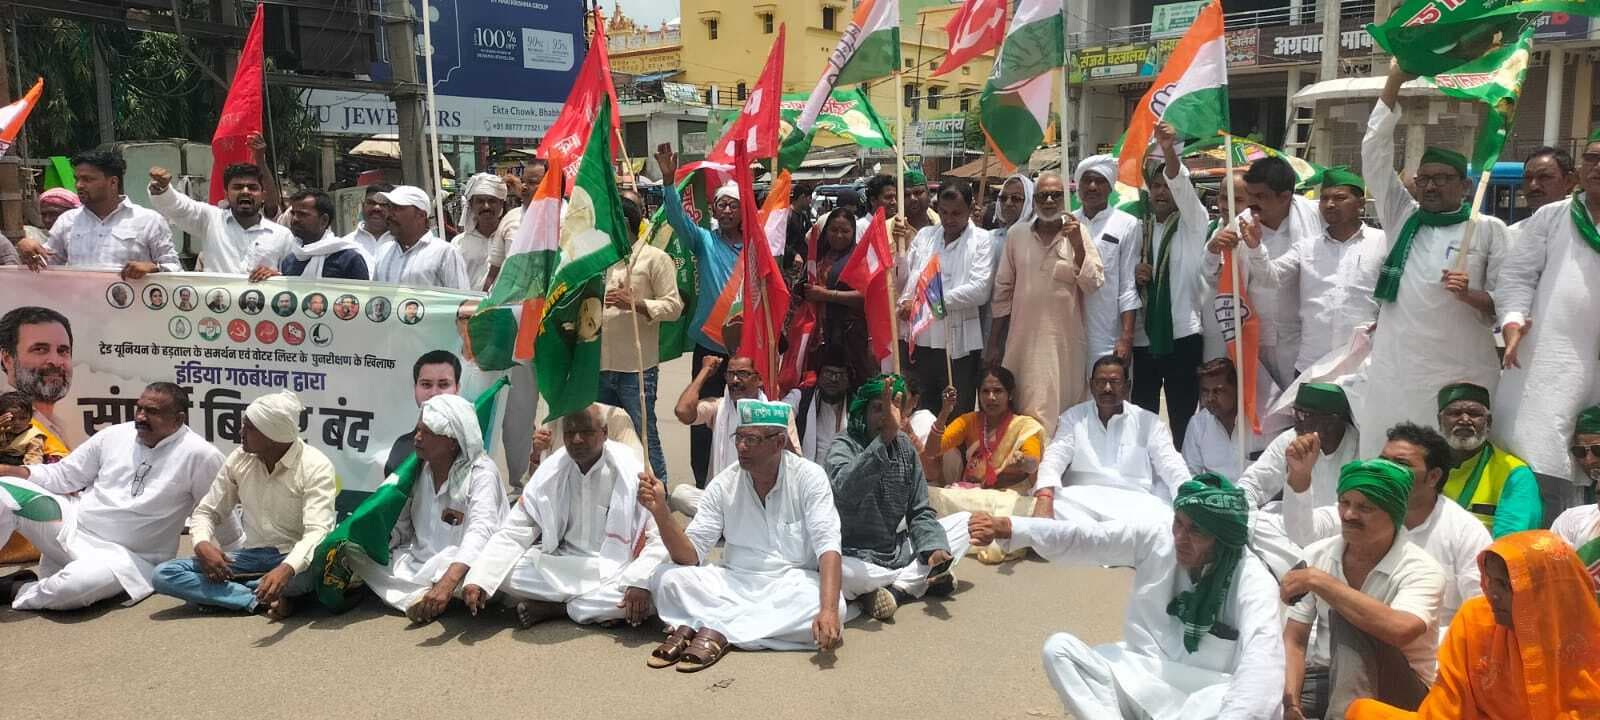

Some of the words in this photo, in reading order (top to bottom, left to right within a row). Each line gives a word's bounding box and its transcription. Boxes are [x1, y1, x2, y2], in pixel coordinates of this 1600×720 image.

[1079, 52, 1106, 70] संजय
[341, 105, 461, 130] JEWERS
[492, 105, 509, 115] Ekta
[99, 341, 112, 355] ट्रेड
[114, 341, 149, 358] यूनियन
[151, 342, 160, 355] के
[162, 345, 191, 358] हड़ताल
[193, 344, 202, 357] के
[204, 345, 236, 359] समर्थन
[238, 348, 250, 360] एवं
[252, 348, 272, 361] वोटर
[274, 349, 297, 362] लिस्ट
[299, 350, 308, 363] के
[312, 352, 352, 367] पुनरीक्षण
[353, 353, 362, 366] के
[364, 354, 396, 369] खिलाफ
[174, 360, 223, 385] इंडिया
[225, 364, 290, 389] गठबंधन
[292, 371, 327, 392] द्वारा
[318, 396, 375, 453] बंद
